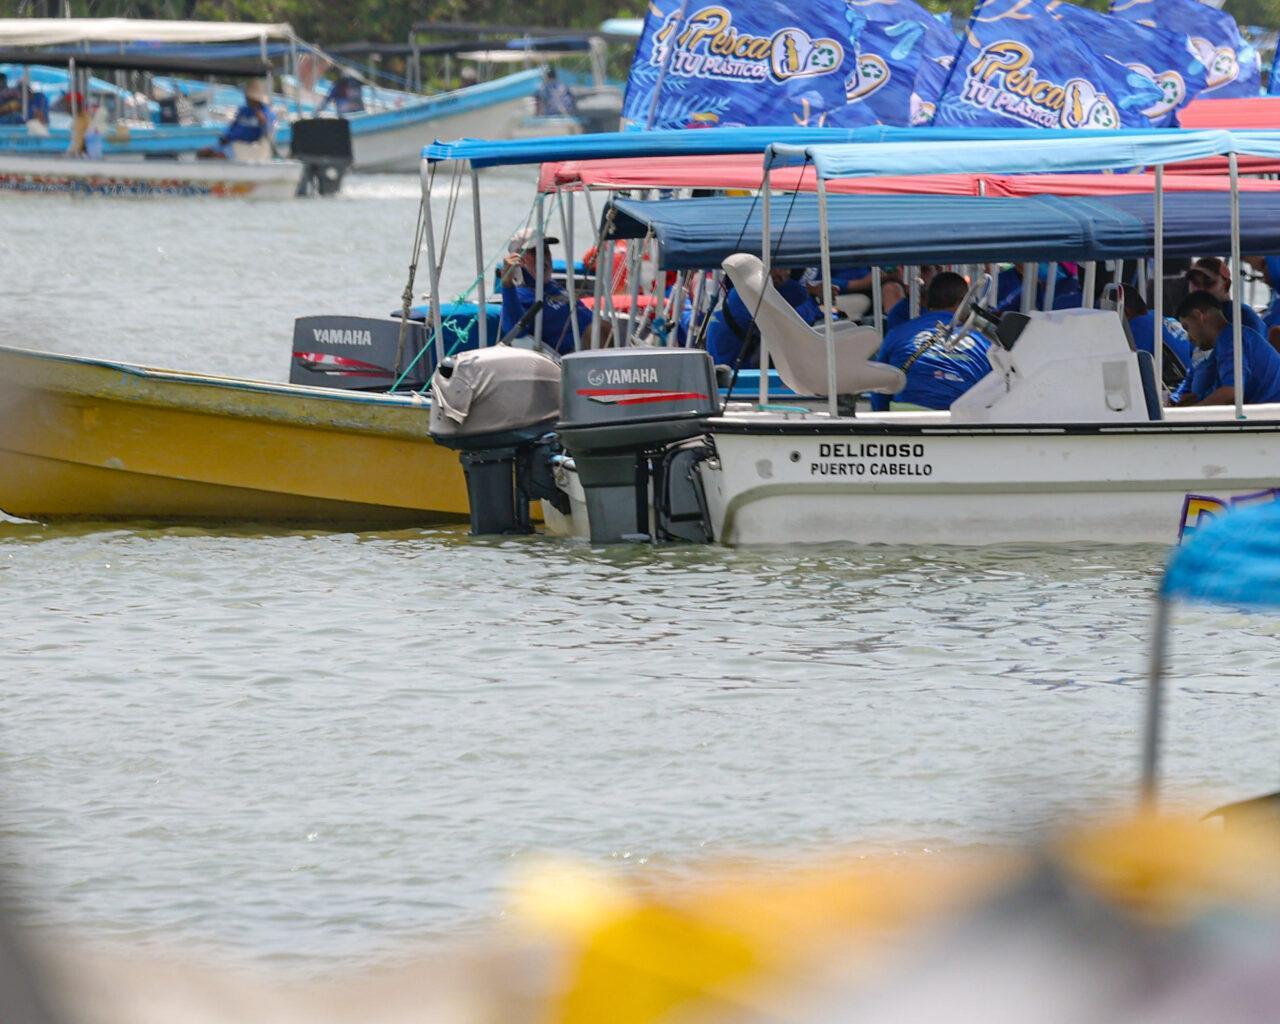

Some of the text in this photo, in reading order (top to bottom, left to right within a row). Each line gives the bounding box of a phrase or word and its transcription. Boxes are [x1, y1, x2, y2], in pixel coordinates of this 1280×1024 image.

[673, 51, 699, 73] TU
[967, 80, 994, 105] TU
[313, 329, 372, 345] YAMAHA
[605, 368, 658, 384] YAMAHA
[819, 443, 924, 457] DELICIOSO
[811, 463, 932, 476] PUERTO CABELLO
